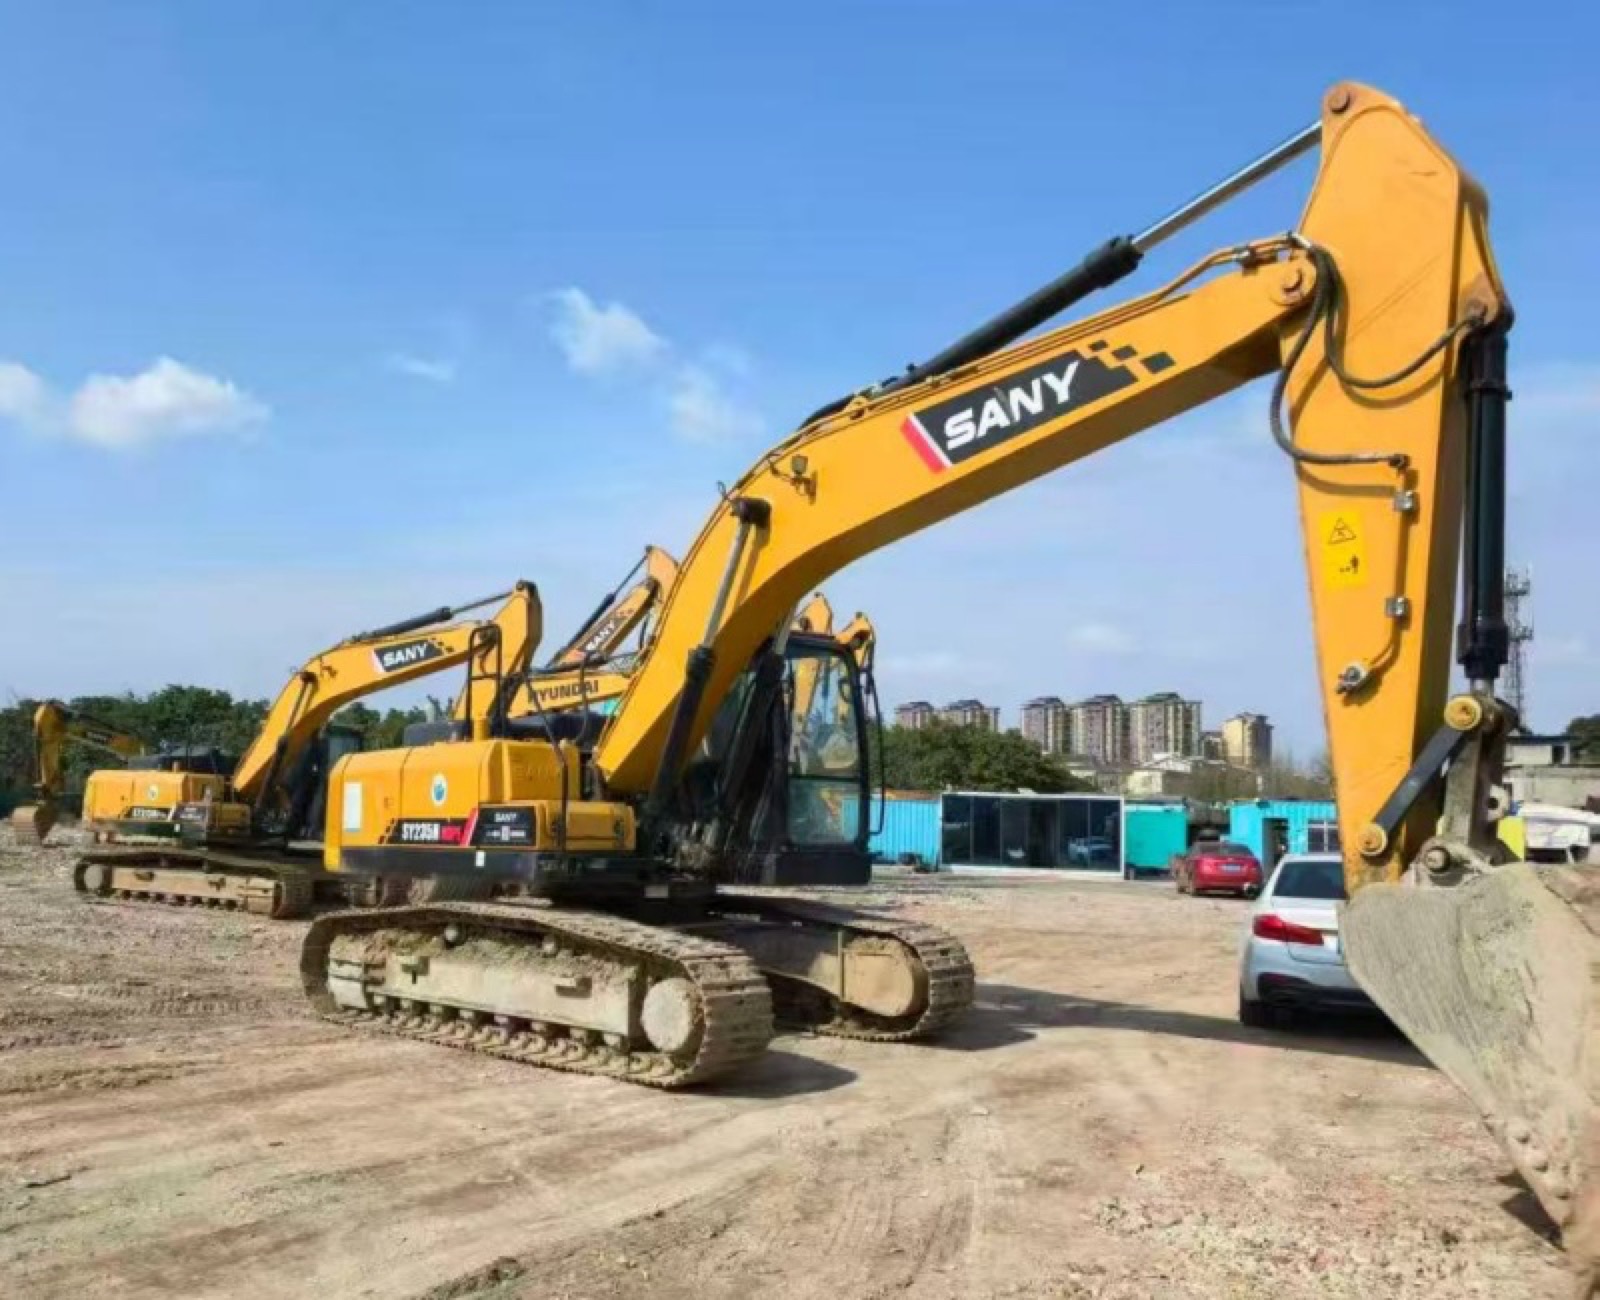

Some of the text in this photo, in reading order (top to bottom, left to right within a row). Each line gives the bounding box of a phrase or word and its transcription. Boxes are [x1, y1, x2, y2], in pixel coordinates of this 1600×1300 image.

[943, 359, 1080, 451] SANY
[585, 619, 615, 651] SANY
[383, 642, 428, 667] SANY
